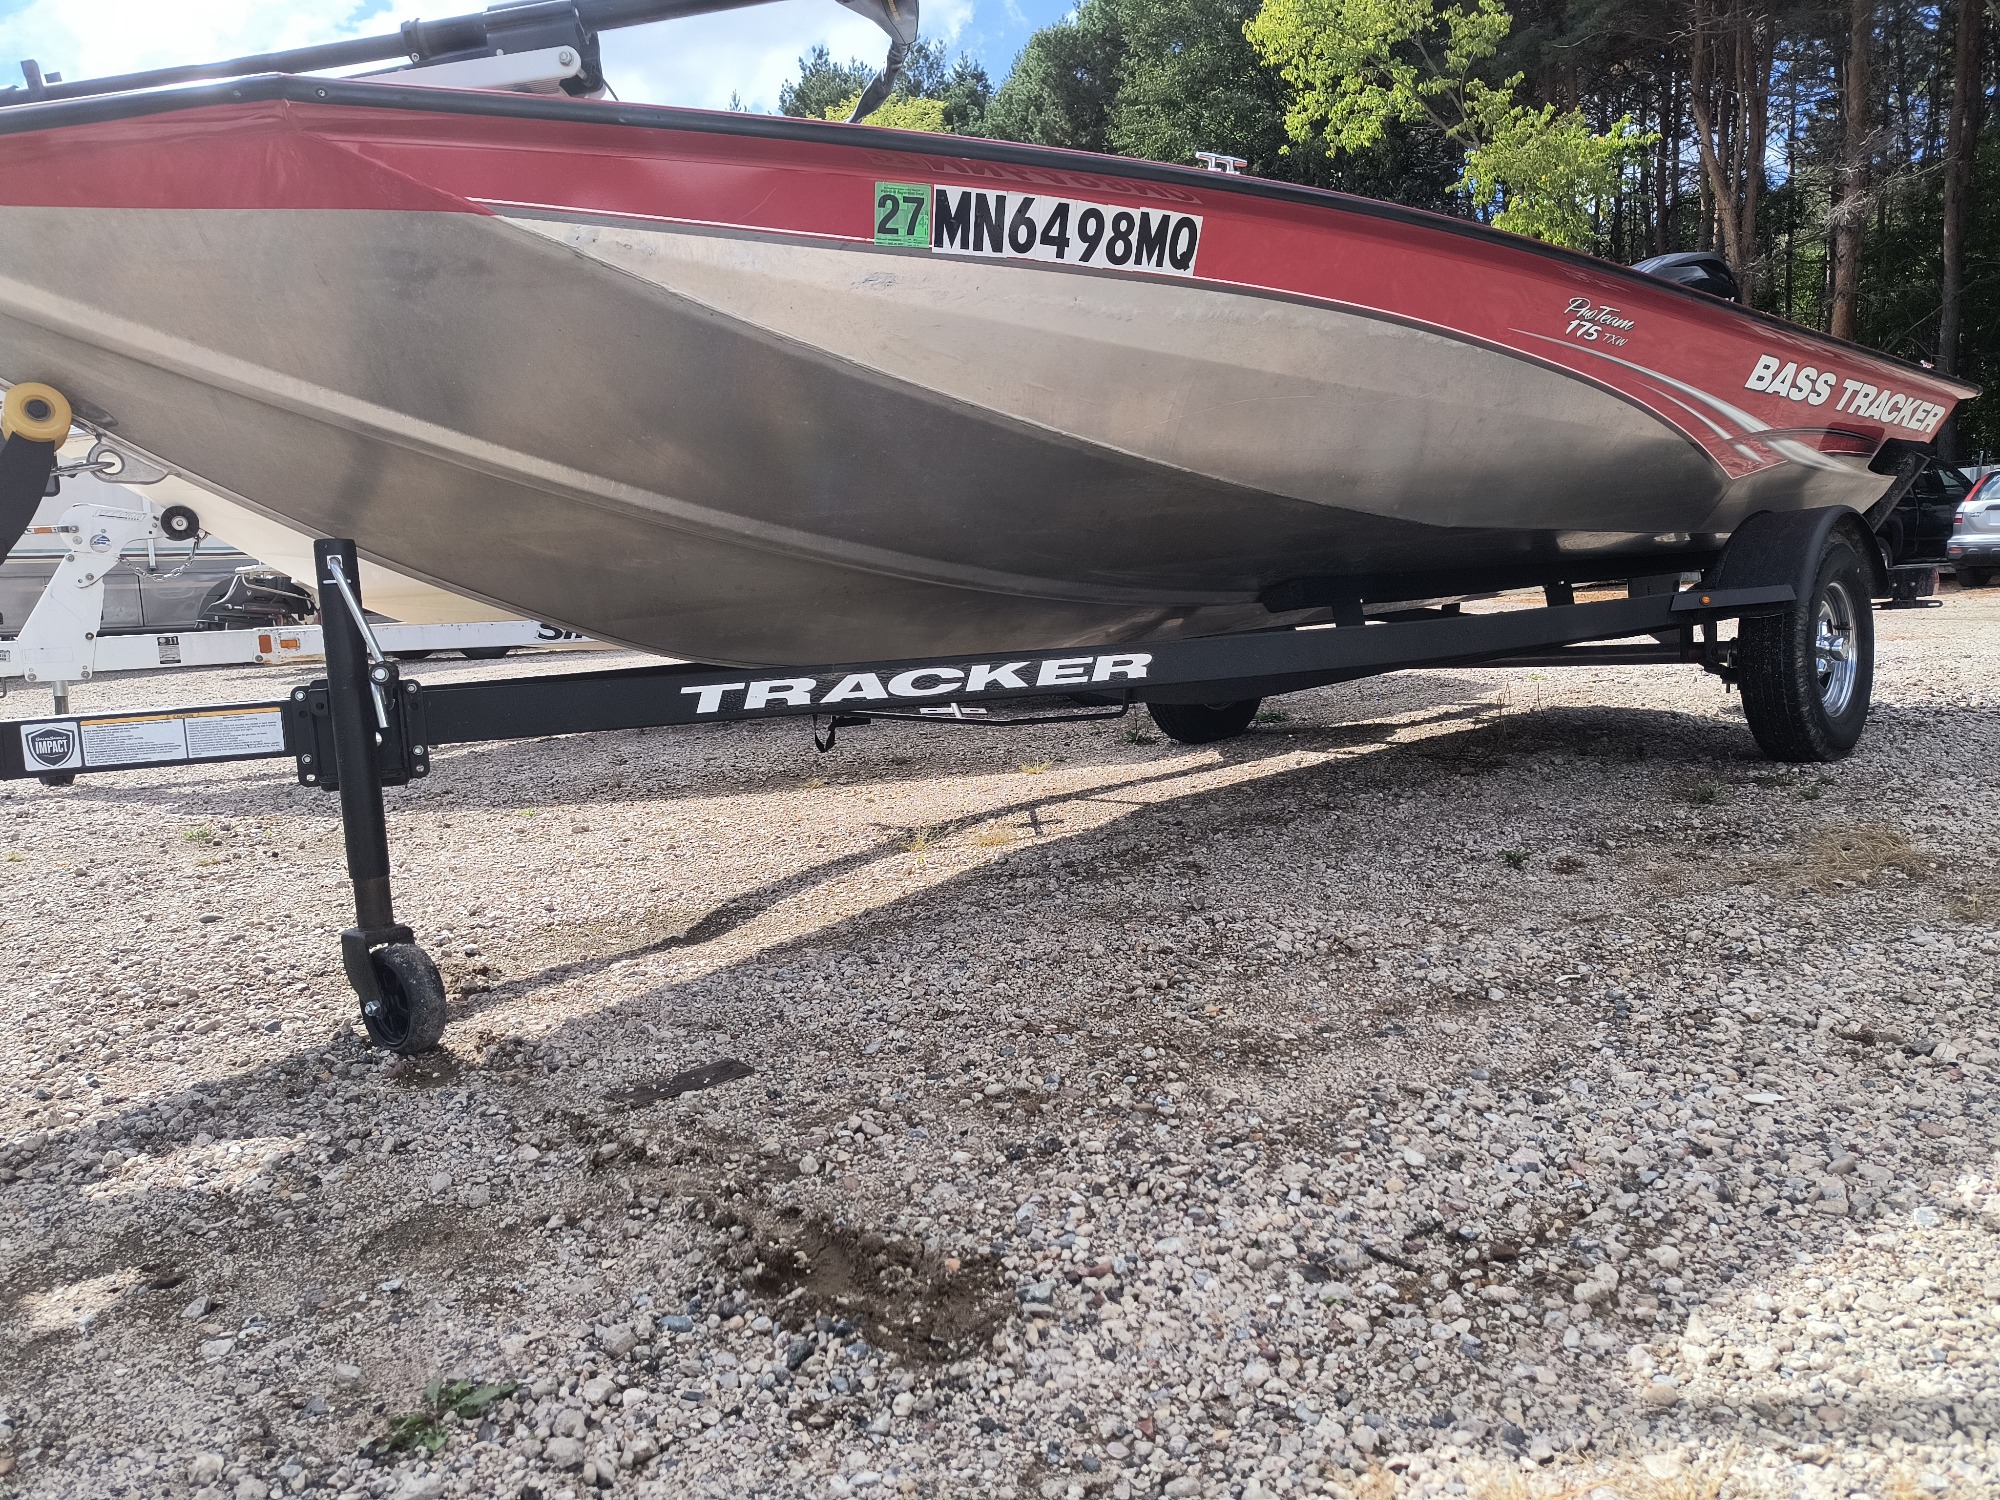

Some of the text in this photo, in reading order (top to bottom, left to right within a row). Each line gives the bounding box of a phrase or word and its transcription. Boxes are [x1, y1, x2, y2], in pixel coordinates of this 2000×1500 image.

[877, 193, 925, 236] 27
[934, 189, 1199, 272] MN6498MQ
[1564, 297, 1635, 330] ProTeam
[1565, 319, 1629, 347] 175 TXW
[1744, 354, 1946, 433] BASS TRACKER
[681, 653, 1154, 714] TRACKER
[35, 740, 68, 754] IMPACT
